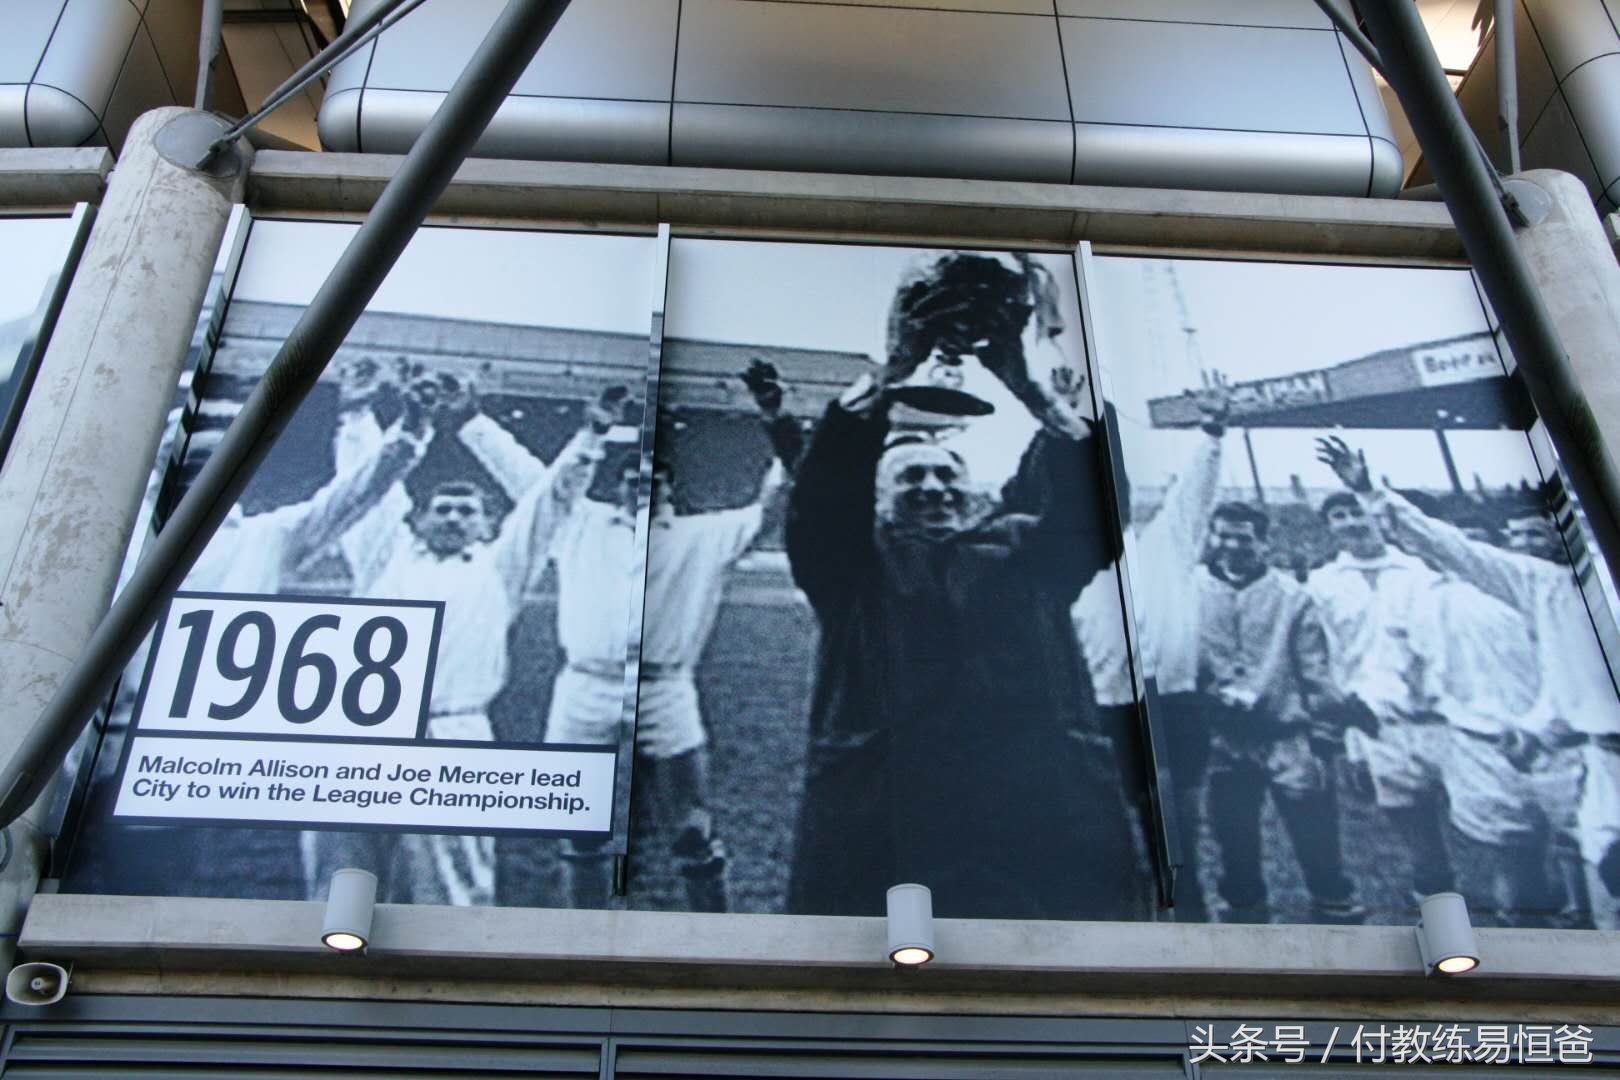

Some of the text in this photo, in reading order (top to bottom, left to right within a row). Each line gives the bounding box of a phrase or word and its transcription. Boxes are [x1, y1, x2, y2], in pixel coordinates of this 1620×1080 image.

[168, 609, 409, 727] 1968
[138, 755, 582, 789] Malcolm Allison and Joe Mercer lead
[132, 778, 591, 815] City to win the League Championship.
